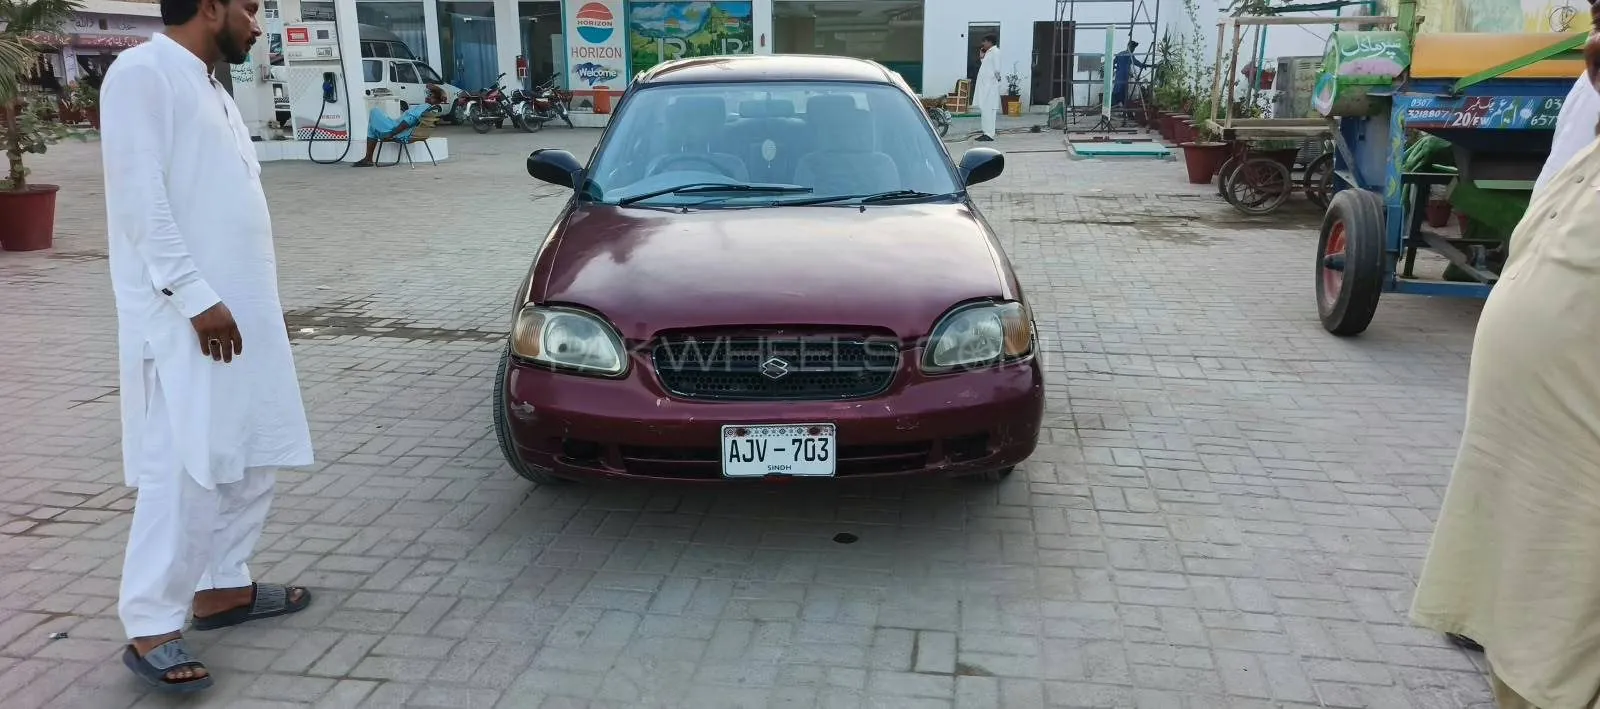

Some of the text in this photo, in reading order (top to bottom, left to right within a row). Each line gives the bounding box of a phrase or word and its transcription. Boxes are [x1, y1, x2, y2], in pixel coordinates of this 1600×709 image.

[571, 47, 622, 58] HORIZON
[578, 67, 617, 77] Welcome
[1544, 98, 1562, 110] 03
[1531, 114, 1558, 126] 657
[729, 439, 767, 463] AJV
[792, 438, 829, 462] 703
